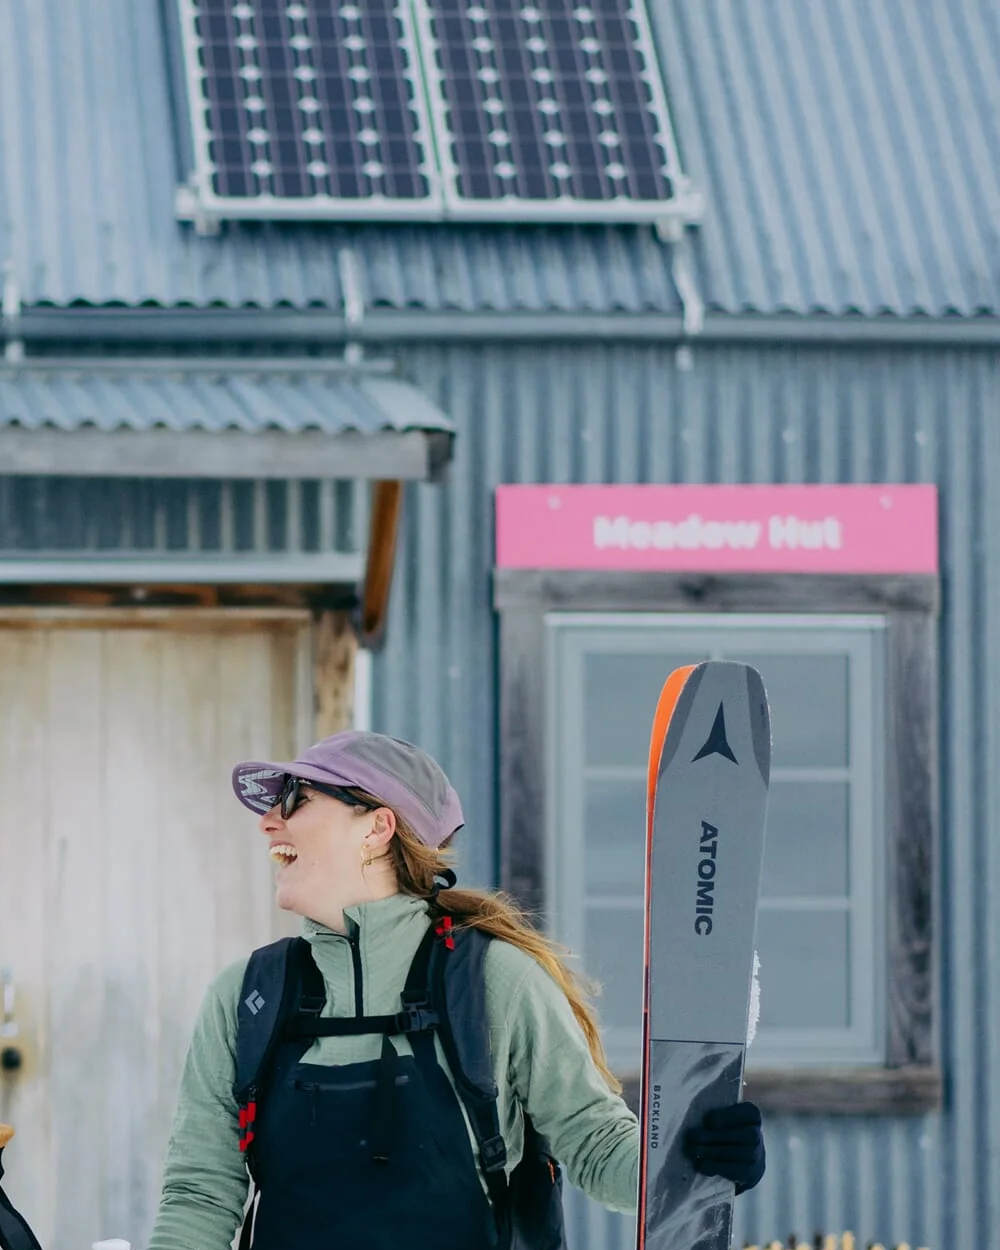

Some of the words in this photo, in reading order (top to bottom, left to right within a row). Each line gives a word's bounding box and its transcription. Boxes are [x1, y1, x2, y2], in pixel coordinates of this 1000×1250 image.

[593, 515, 761, 550] Meadow
[769, 516, 842, 550] Hut
[694, 820, 719, 936] ATOMIC
[650, 1084, 662, 1150] BACKLAND
